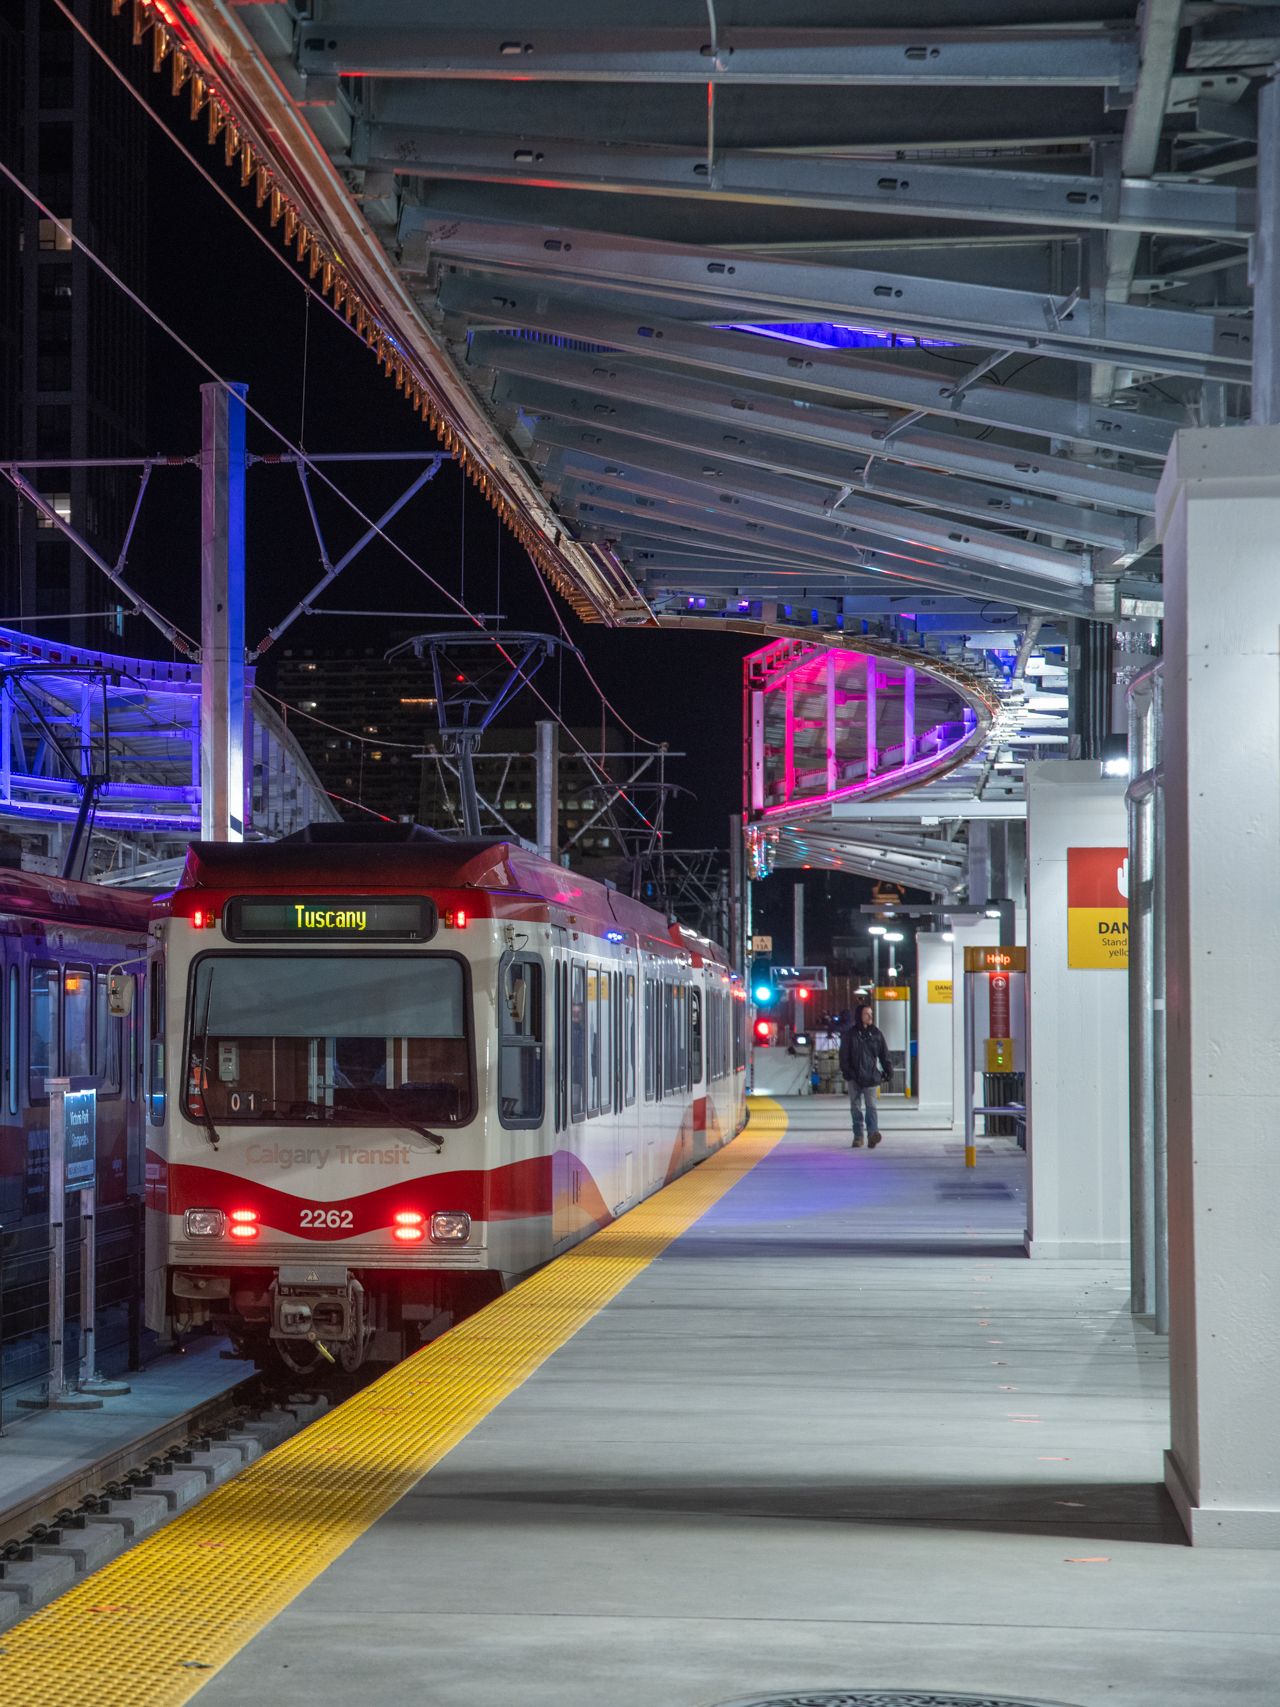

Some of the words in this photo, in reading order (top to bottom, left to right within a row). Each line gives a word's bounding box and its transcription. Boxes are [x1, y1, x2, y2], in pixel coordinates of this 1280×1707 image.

[294, 905, 367, 931] Tuscany
[1102, 938, 1128, 947] Stand
[986, 954, 1011, 966] Help
[244, 1143, 331, 1169] Calgary
[335, 1144, 411, 1165] Transit
[299, 1209, 354, 1229] 2262
